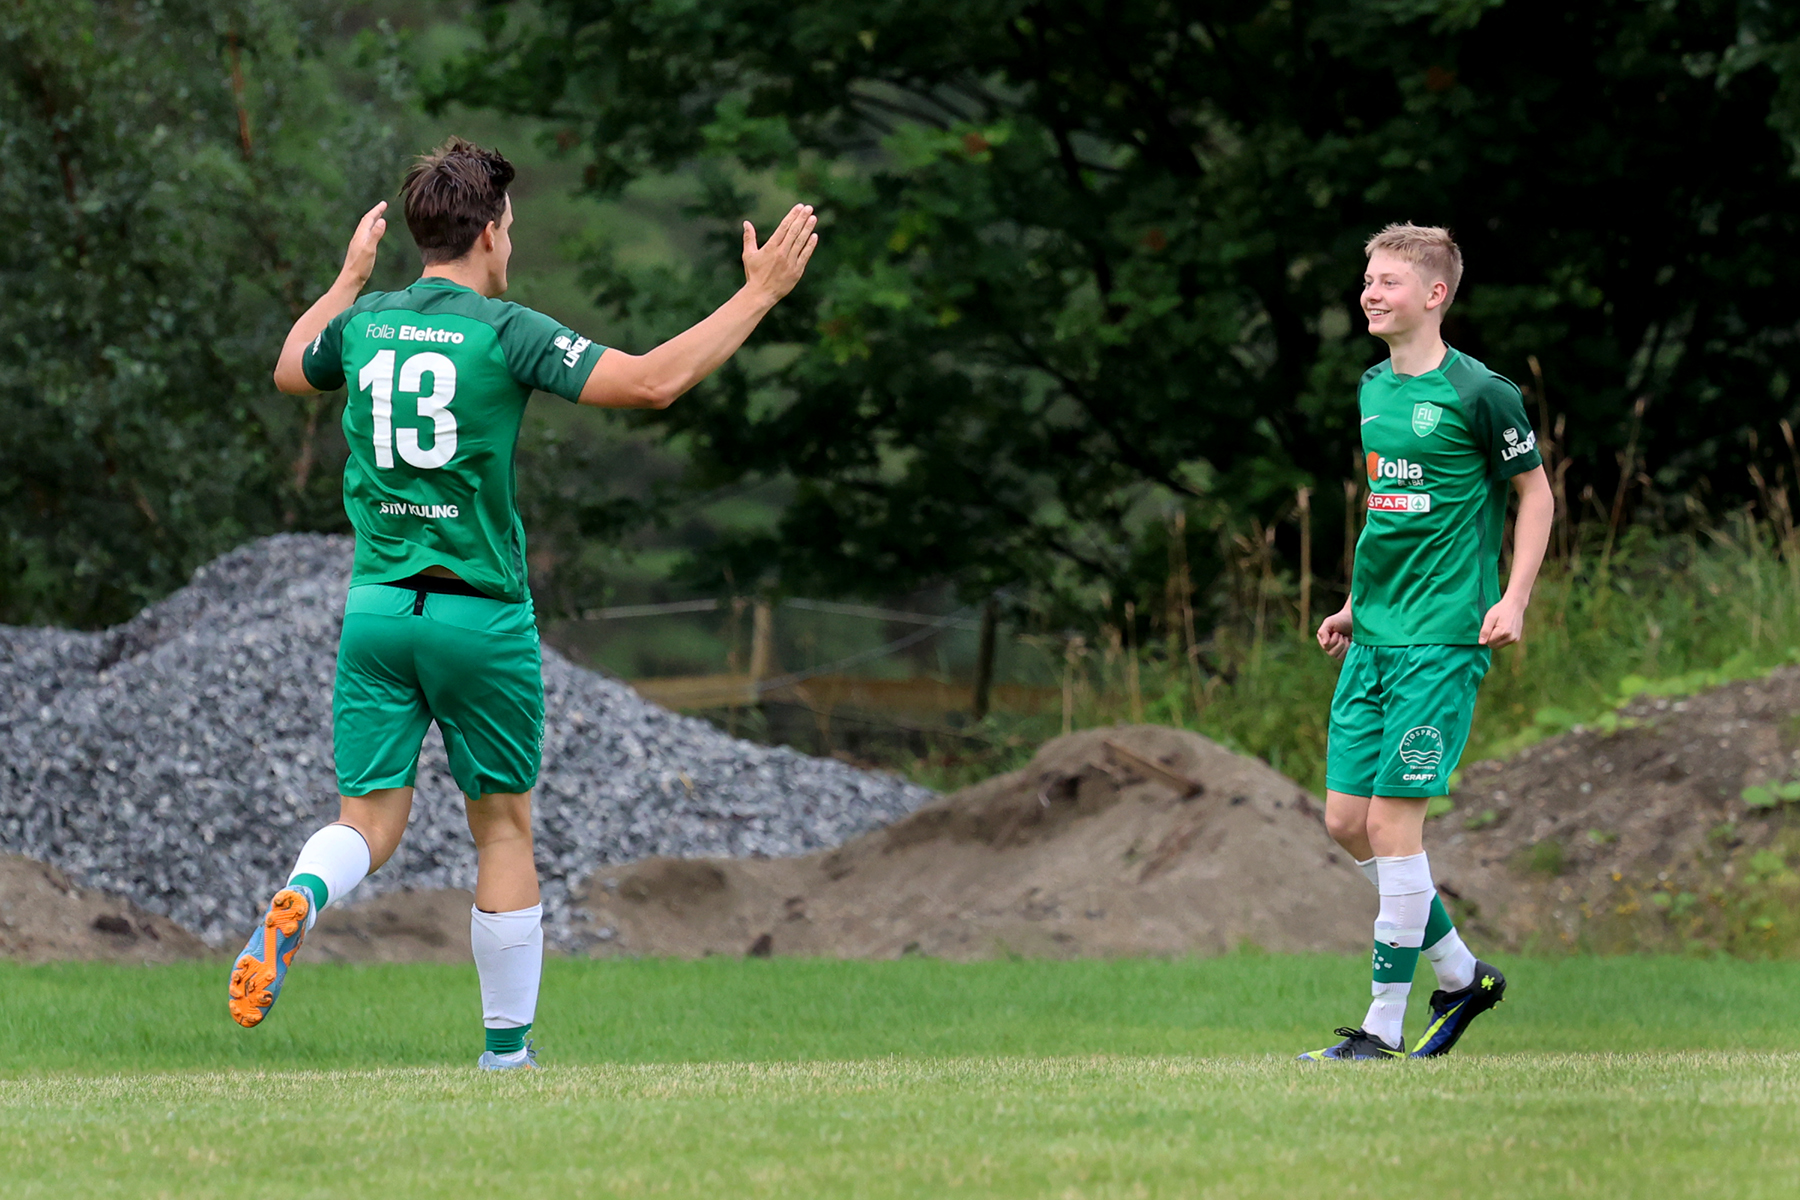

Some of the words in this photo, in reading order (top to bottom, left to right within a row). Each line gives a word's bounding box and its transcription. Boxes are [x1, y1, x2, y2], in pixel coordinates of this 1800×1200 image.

[366, 324, 395, 339] Folla
[399, 325, 464, 344] Elektro
[358, 349, 457, 469] 13
[1417, 408, 1434, 421] FIL
[1377, 457, 1423, 479] folla
[1369, 495, 1407, 508] SPAR
[408, 504, 459, 518] KULING
